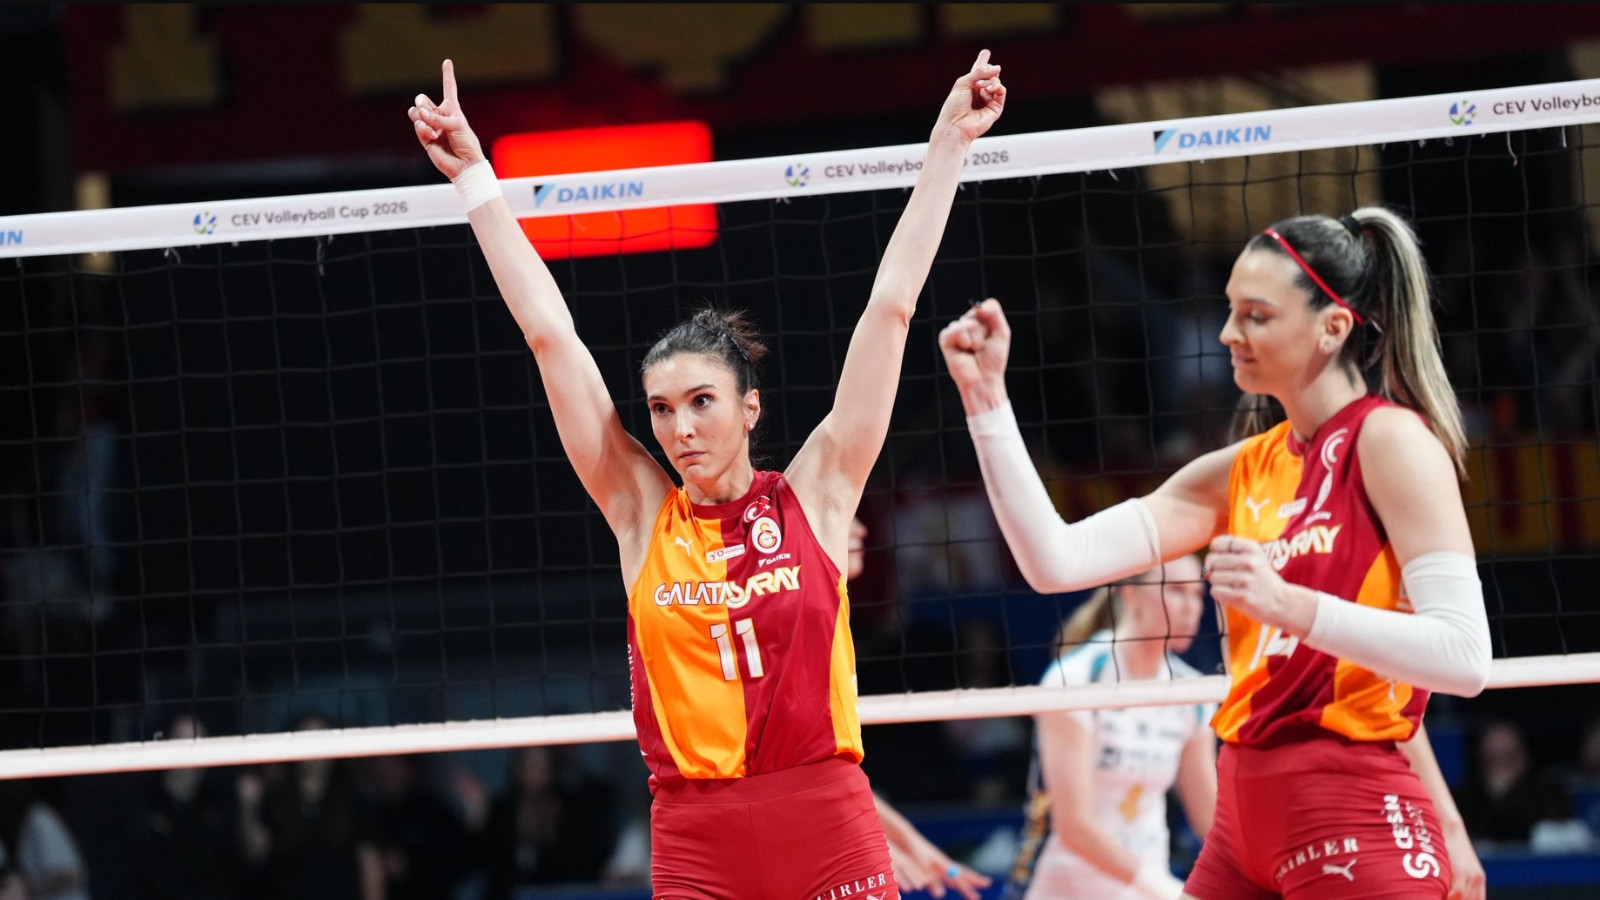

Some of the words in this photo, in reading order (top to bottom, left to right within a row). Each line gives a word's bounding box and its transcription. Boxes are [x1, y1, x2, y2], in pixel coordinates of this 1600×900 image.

[1492, 101, 1526, 115] CEV
[1530, 94, 1600, 111] Volleyba
[1178, 125, 1271, 149] DAIKIN
[824, 164, 855, 178] CEV
[858, 158, 925, 175] Volleyba
[972, 150, 1010, 165] 2026
[557, 181, 644, 204] DAIKIN
[231, 213, 260, 227] CEV
[264, 206, 336, 224] Volleyball
[339, 206, 369, 219] Cup
[373, 201, 409, 216] 2026
[766, 553, 791, 565] DAIKIN
[654, 565, 801, 609] GALATASARAY
[710, 617, 764, 682] 11
